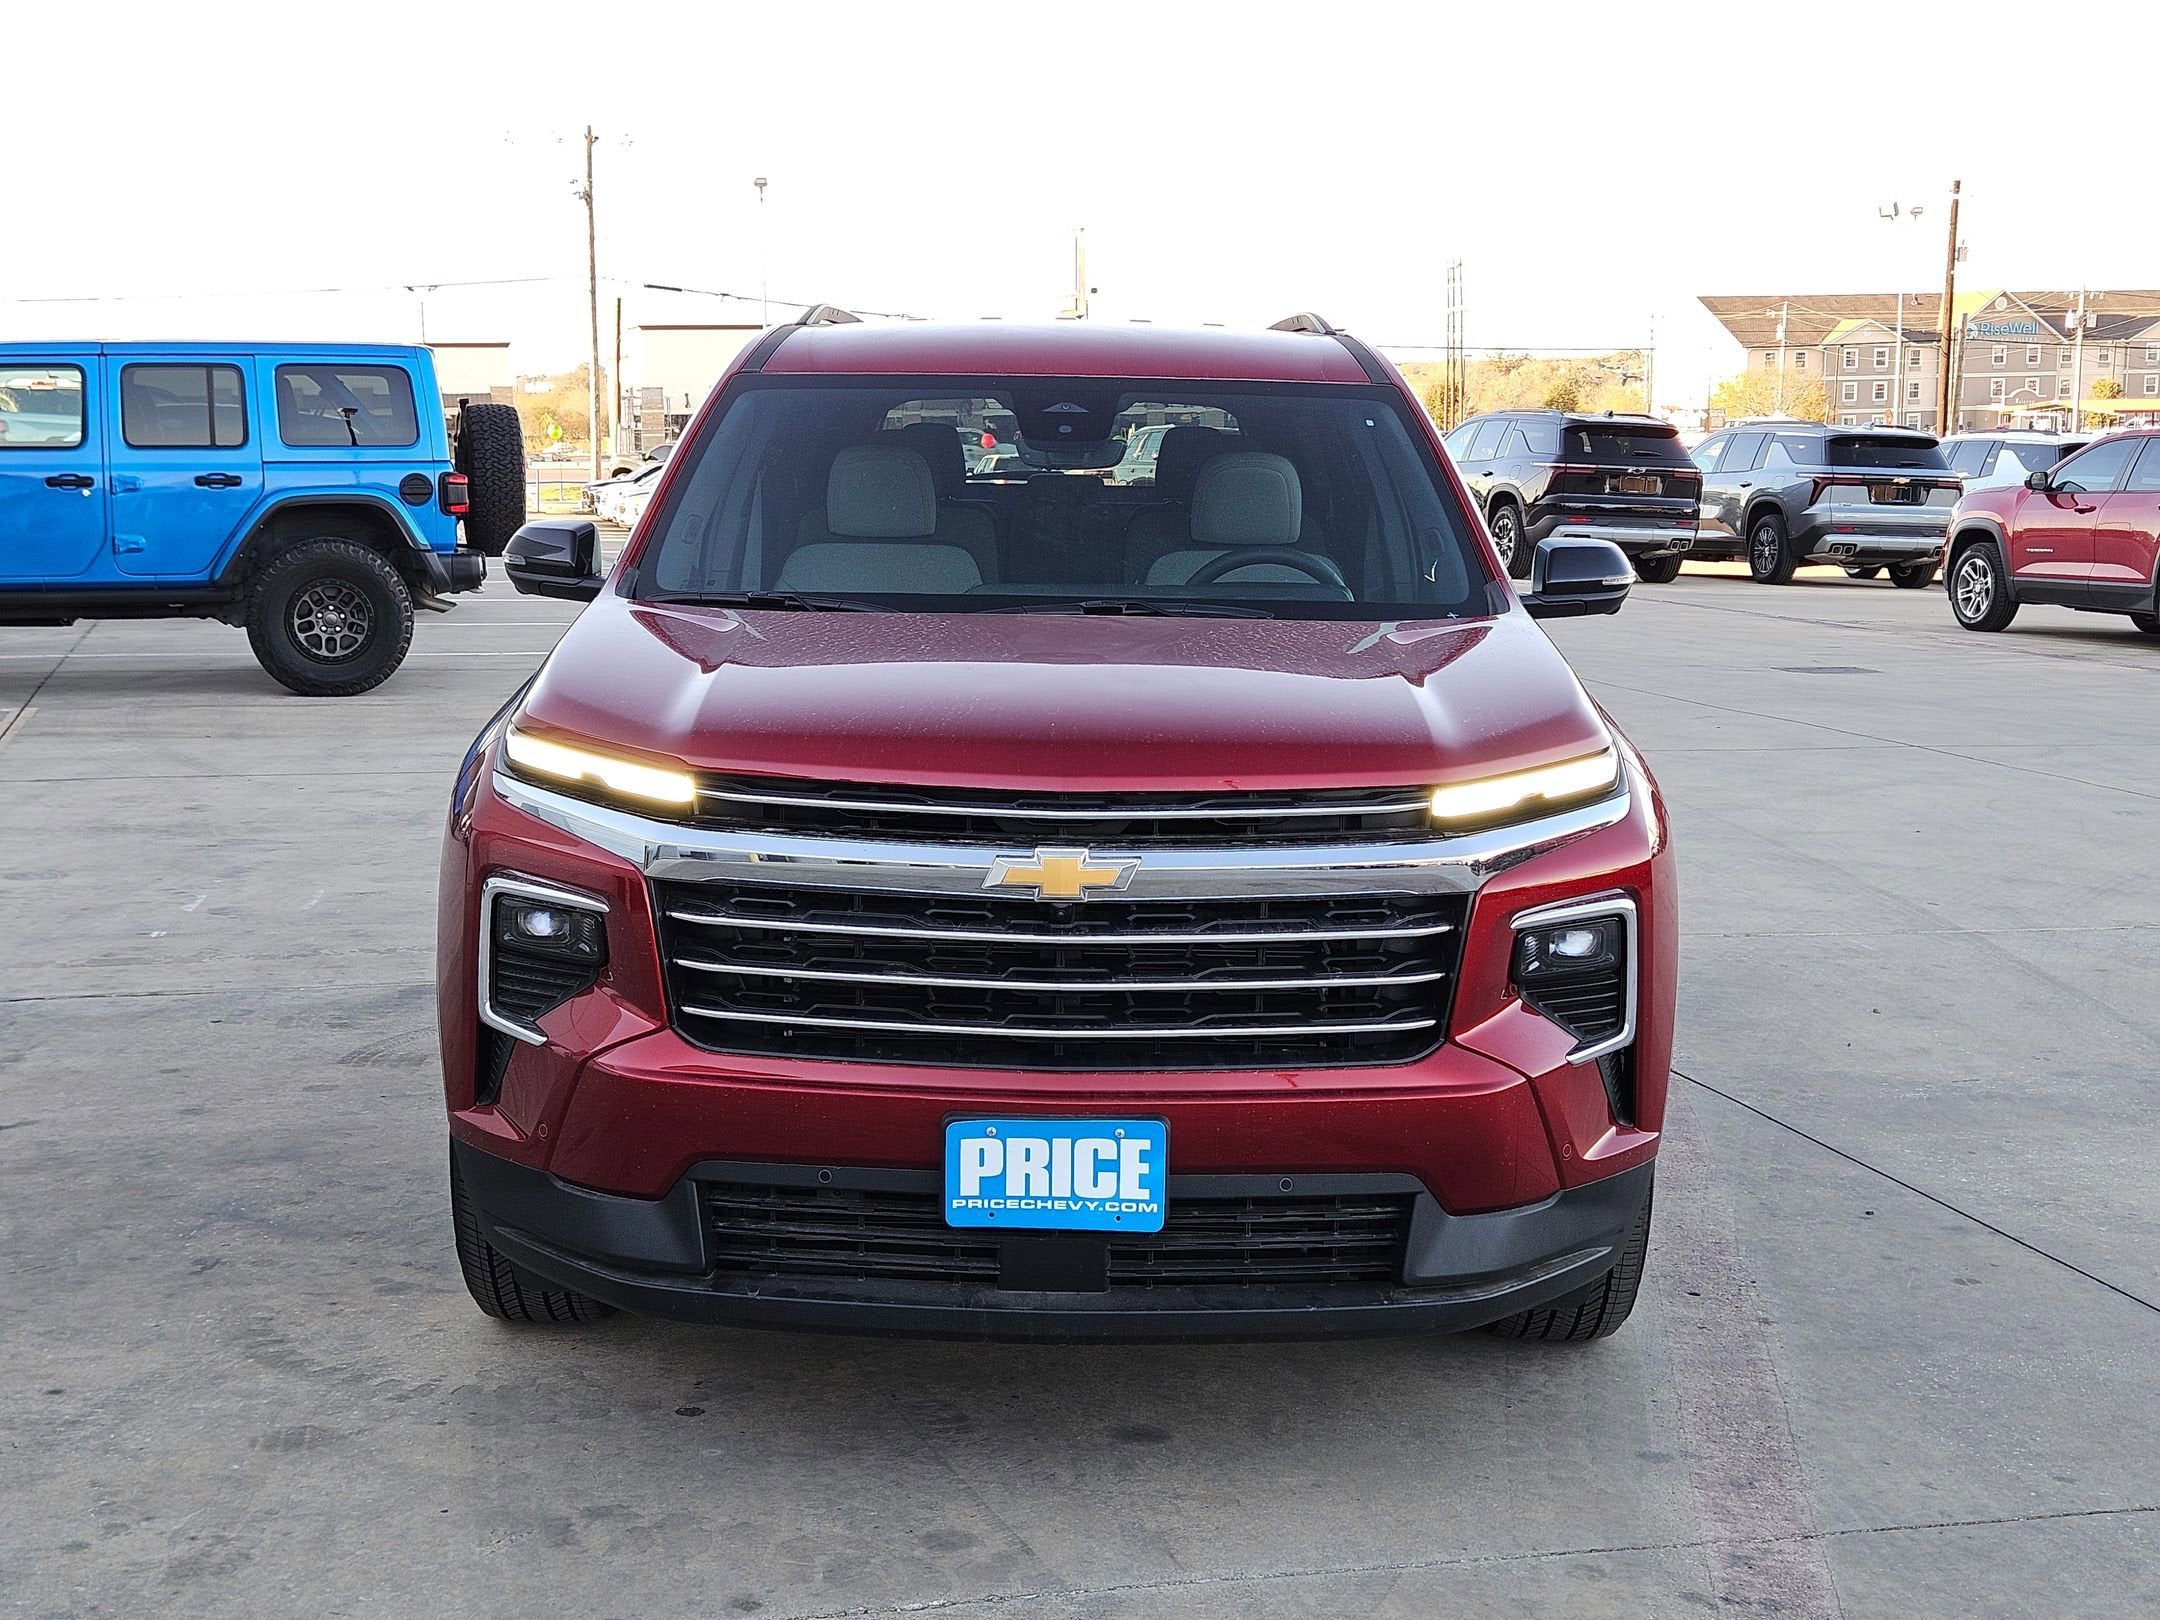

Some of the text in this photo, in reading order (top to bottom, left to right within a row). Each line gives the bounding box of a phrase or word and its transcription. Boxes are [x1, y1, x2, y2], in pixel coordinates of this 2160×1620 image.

[1980, 322, 2039, 335] RiseWell
[960, 1137, 1151, 1200] PRICE
[952, 1199, 1158, 1213] PRICECHEVY.COM
